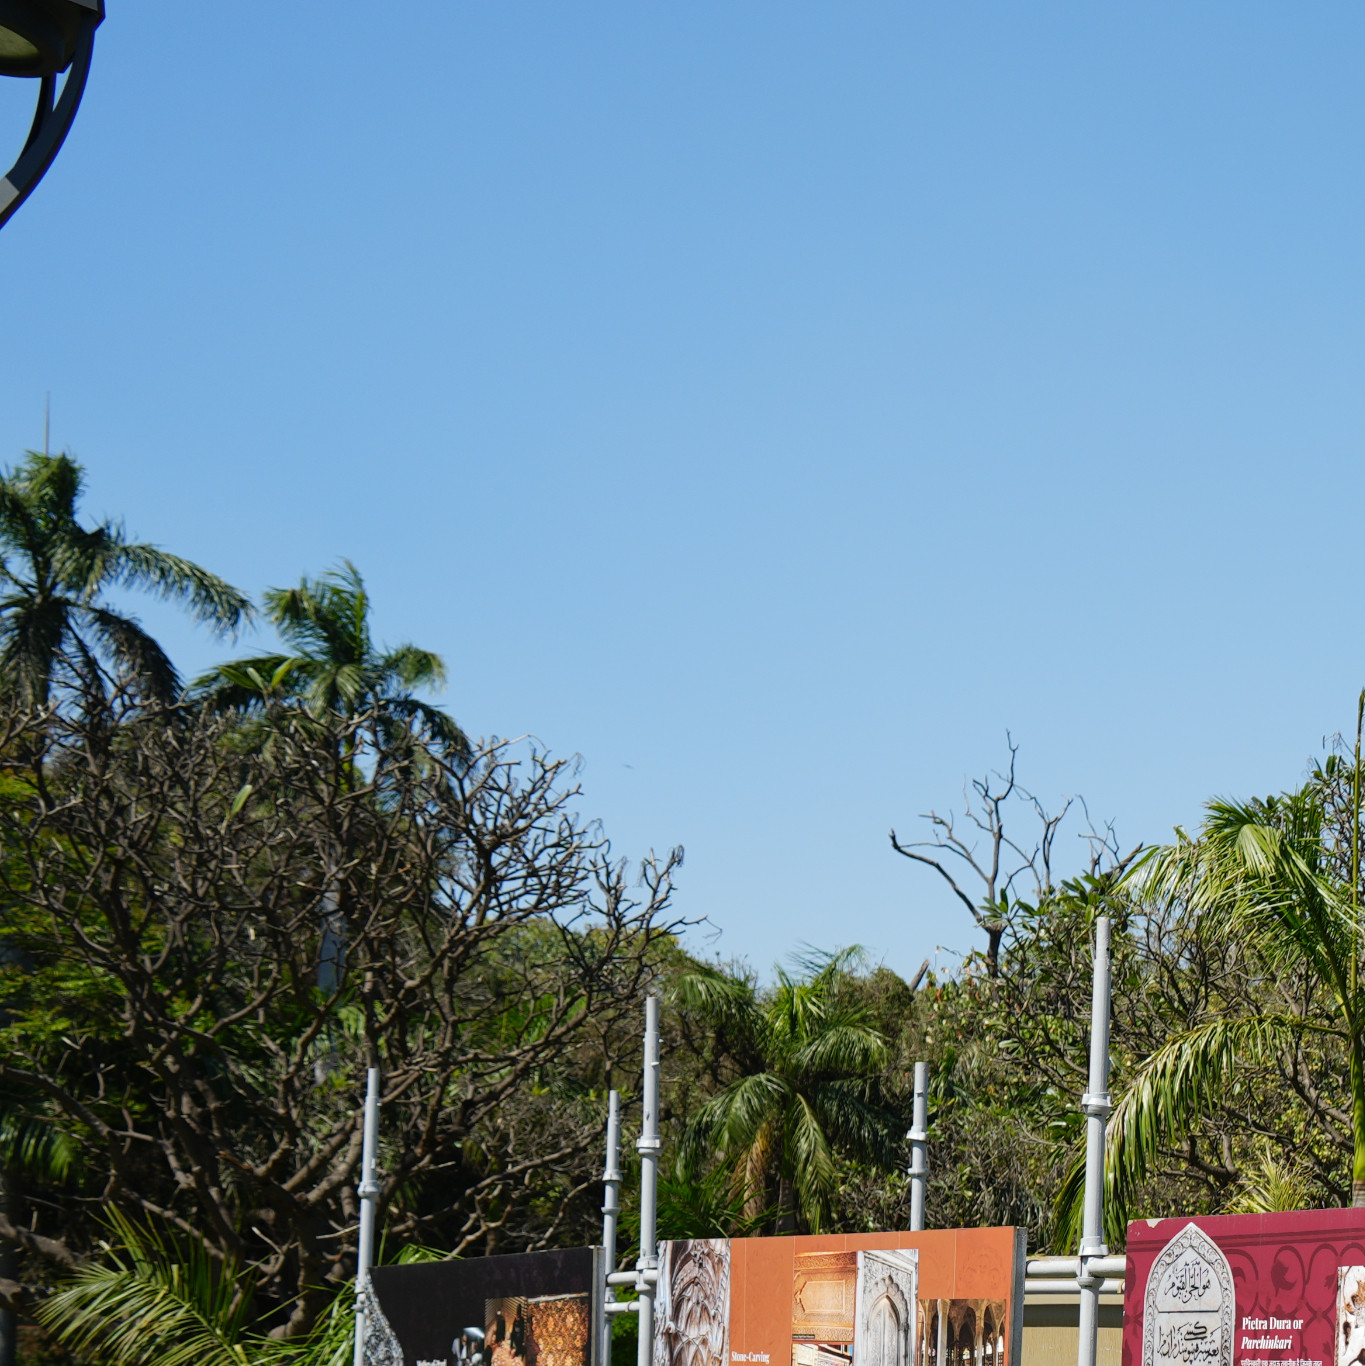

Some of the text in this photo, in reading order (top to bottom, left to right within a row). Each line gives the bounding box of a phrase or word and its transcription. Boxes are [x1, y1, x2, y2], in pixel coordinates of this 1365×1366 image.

[1242, 1316, 1304, 1330] Pietra Dura or
[1241, 1335, 1292, 1349] Parchinkari
[732, 1351, 770, 1364] Stone-Carving
